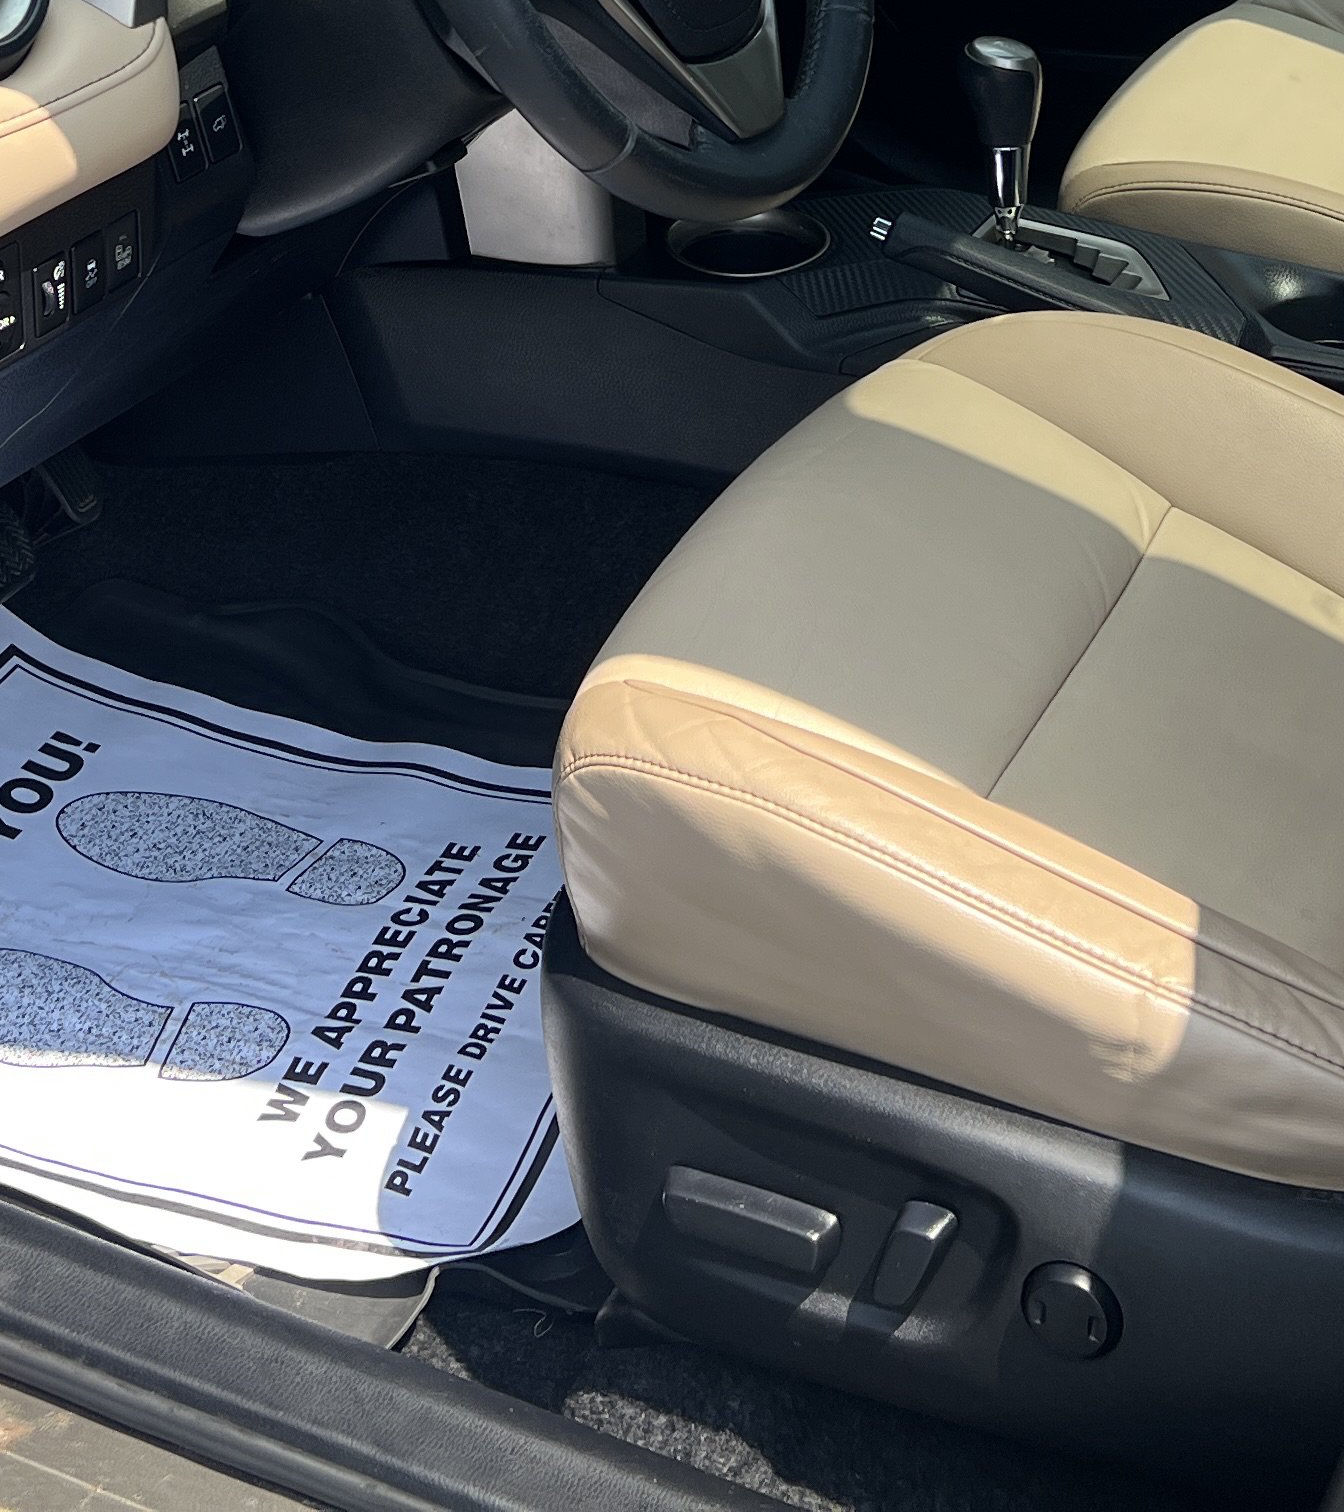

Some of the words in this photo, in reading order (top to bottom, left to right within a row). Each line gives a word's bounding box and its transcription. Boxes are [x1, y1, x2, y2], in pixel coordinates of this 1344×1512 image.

[256, 1055, 330, 1124] WE
[311, 841, 482, 1050] APPRECIATE
[301, 1037, 408, 1162] YOUR
[383, 832, 547, 1035] PATRONAGE
[383, 1063, 474, 1198] PLEASE
[456, 973, 528, 1061] DRIVE
